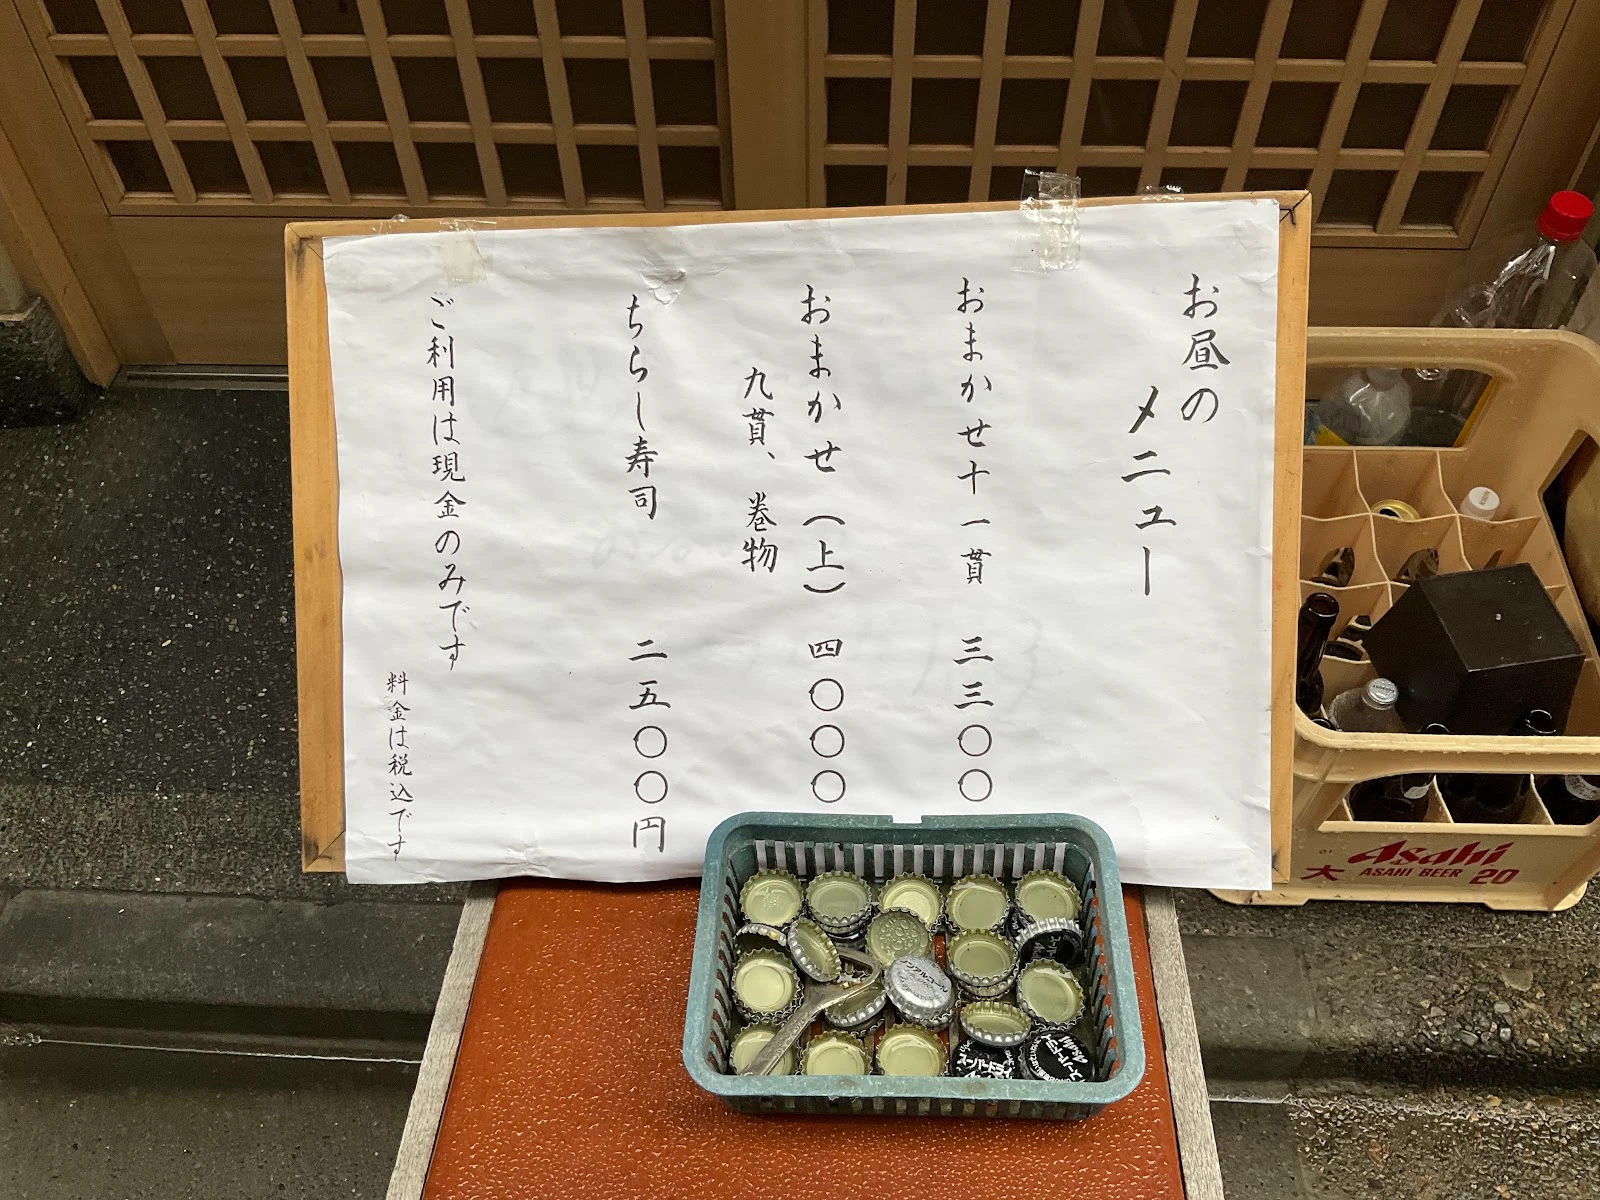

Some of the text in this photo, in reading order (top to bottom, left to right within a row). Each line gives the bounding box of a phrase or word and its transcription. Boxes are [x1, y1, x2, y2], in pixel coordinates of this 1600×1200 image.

[624, 293, 659, 521] ちらし寿司
[1181, 272, 1231, 424] お昼の
[426, 291, 471, 671] ご利用は現金のみです
[800, 283, 847, 594] おまかせ（上）
[956, 276, 994, 586] おまかせ十一貫
[1120, 385, 1178, 597] メニュー
[385, 670, 415, 862] 料金は税込です
[1301, 864, 1346, 882] 大
[1348, 840, 1516, 866] Asahi
[1359, 867, 1464, 878] ASAHI BEER
[1468, 868, 1521, 885] 20
[899, 960, 949, 993] ノンアルコール
[1046, 935, 1062, 960] スーパー
